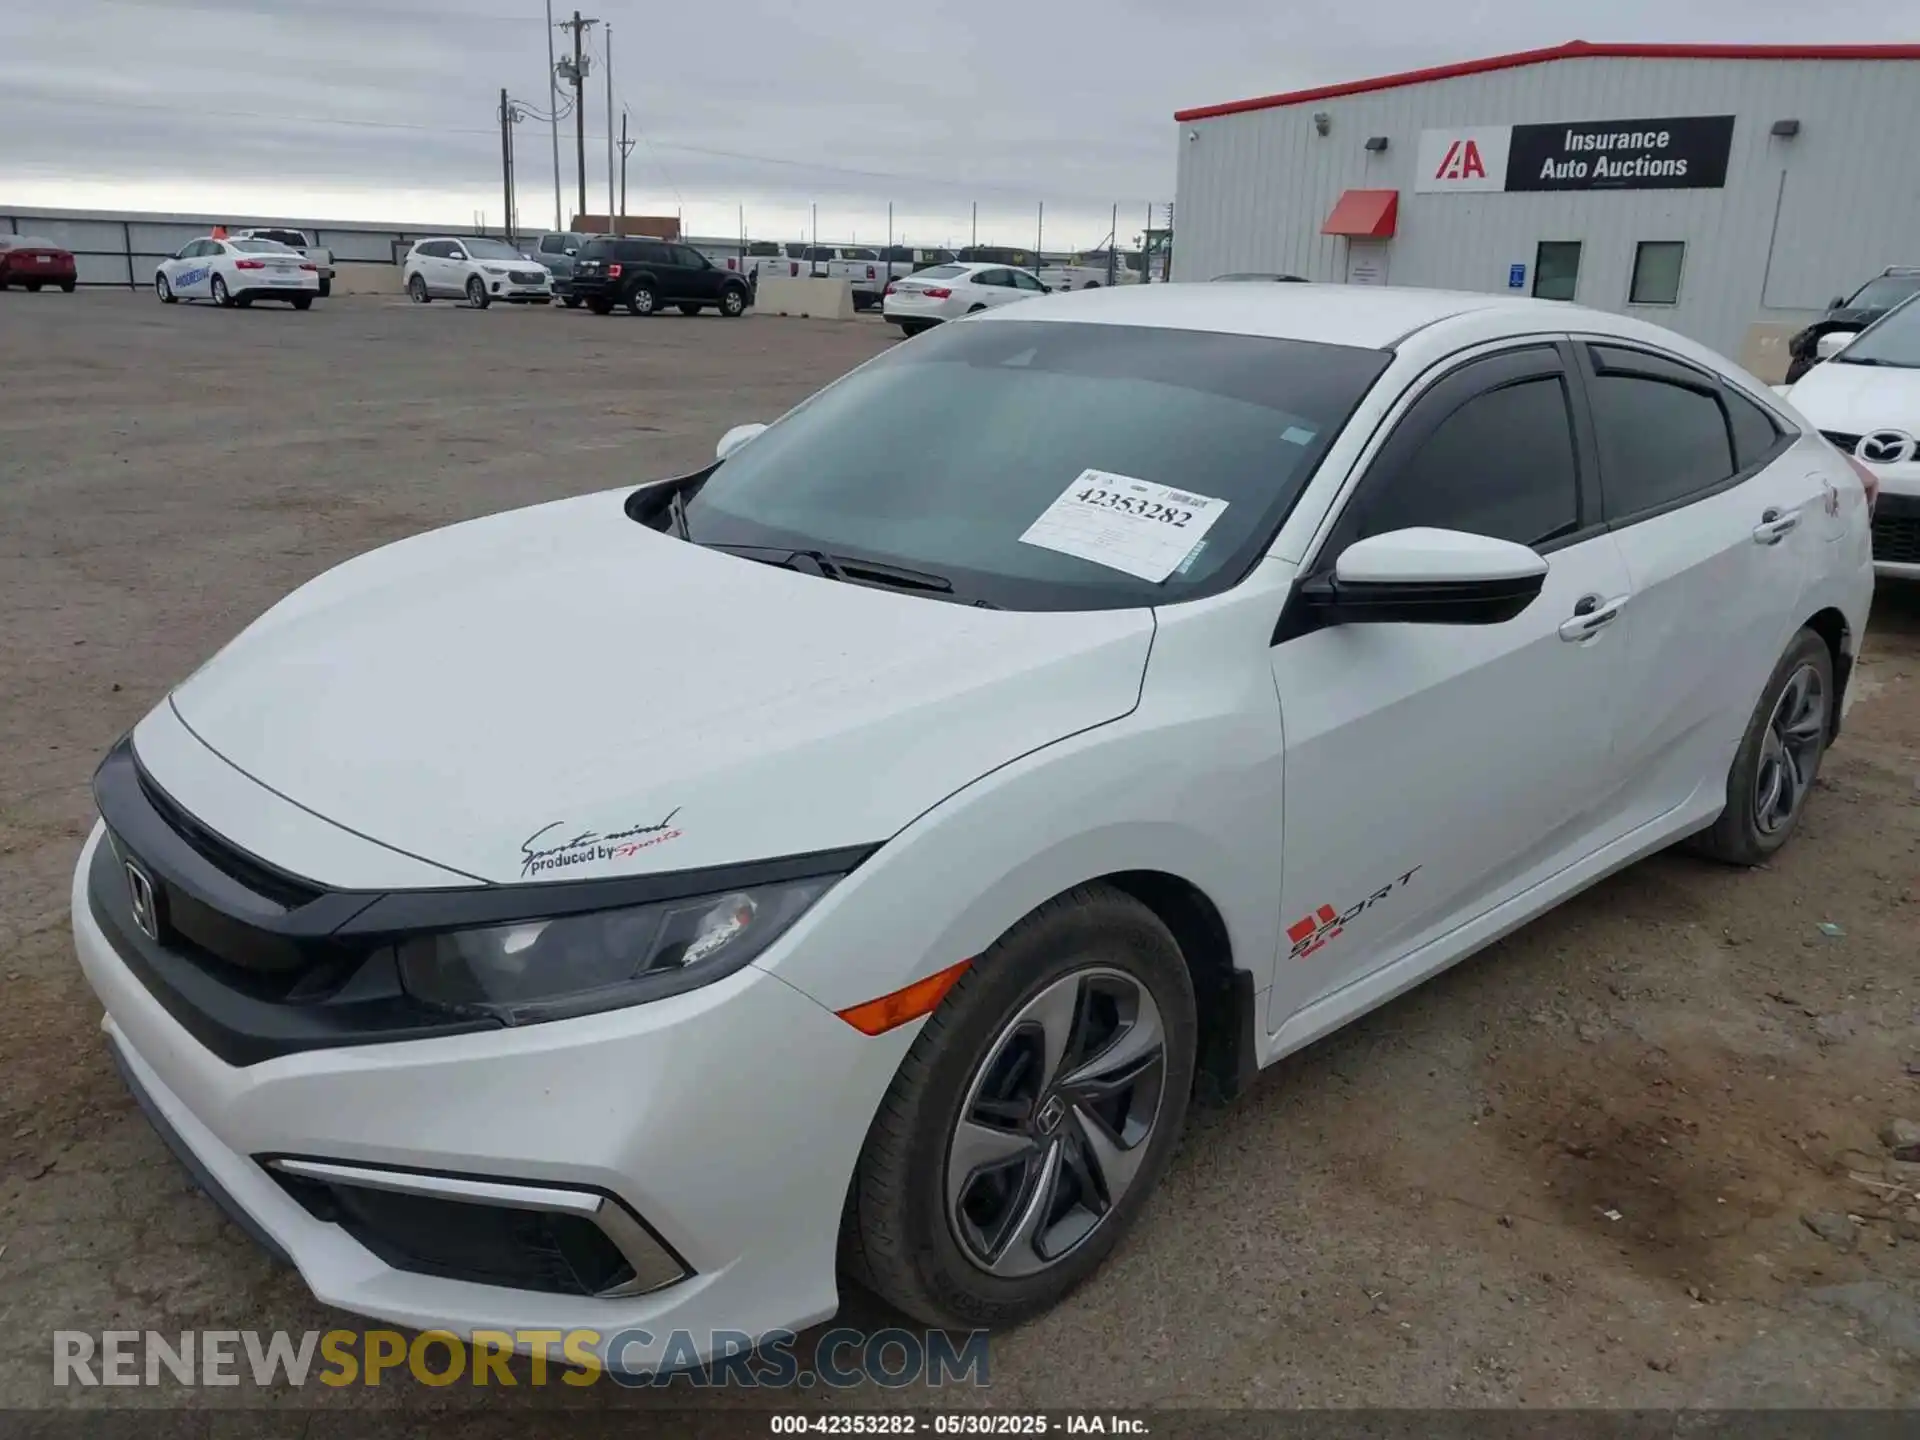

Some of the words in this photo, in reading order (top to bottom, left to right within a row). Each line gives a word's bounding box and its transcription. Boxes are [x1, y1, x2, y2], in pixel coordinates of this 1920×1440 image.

[1564, 129, 1670, 151] Insurance
[1540, 158, 1587, 180] Auto
[1592, 154, 1687, 178] Auctions
[1076, 487, 1192, 528] 42353282
[531, 846, 595, 876] produced
[598, 845, 614, 860] by
[1288, 864, 1422, 960] SPORT
